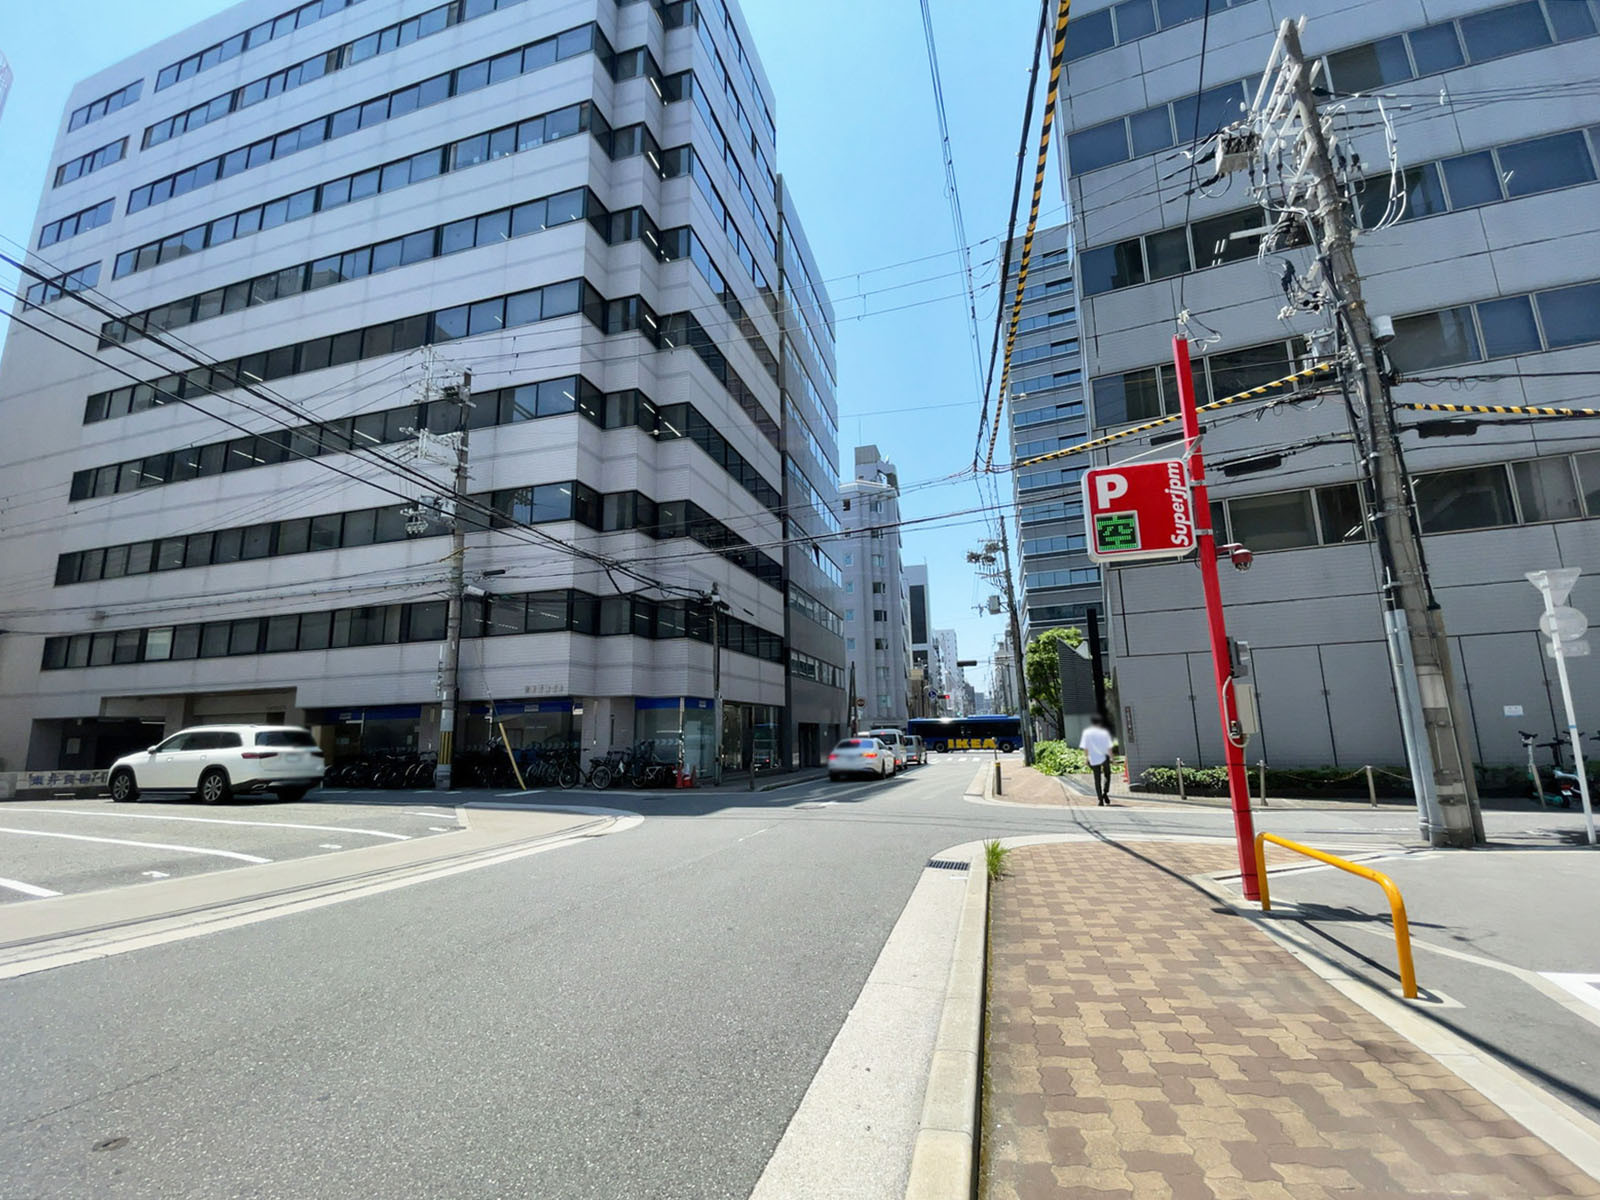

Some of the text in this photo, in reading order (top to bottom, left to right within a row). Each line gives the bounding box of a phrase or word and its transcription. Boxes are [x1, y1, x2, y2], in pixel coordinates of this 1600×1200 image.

[1095, 474, 1128, 509] P
[1097, 515, 1138, 551] 空
[947, 738, 997, 749] IKEA
